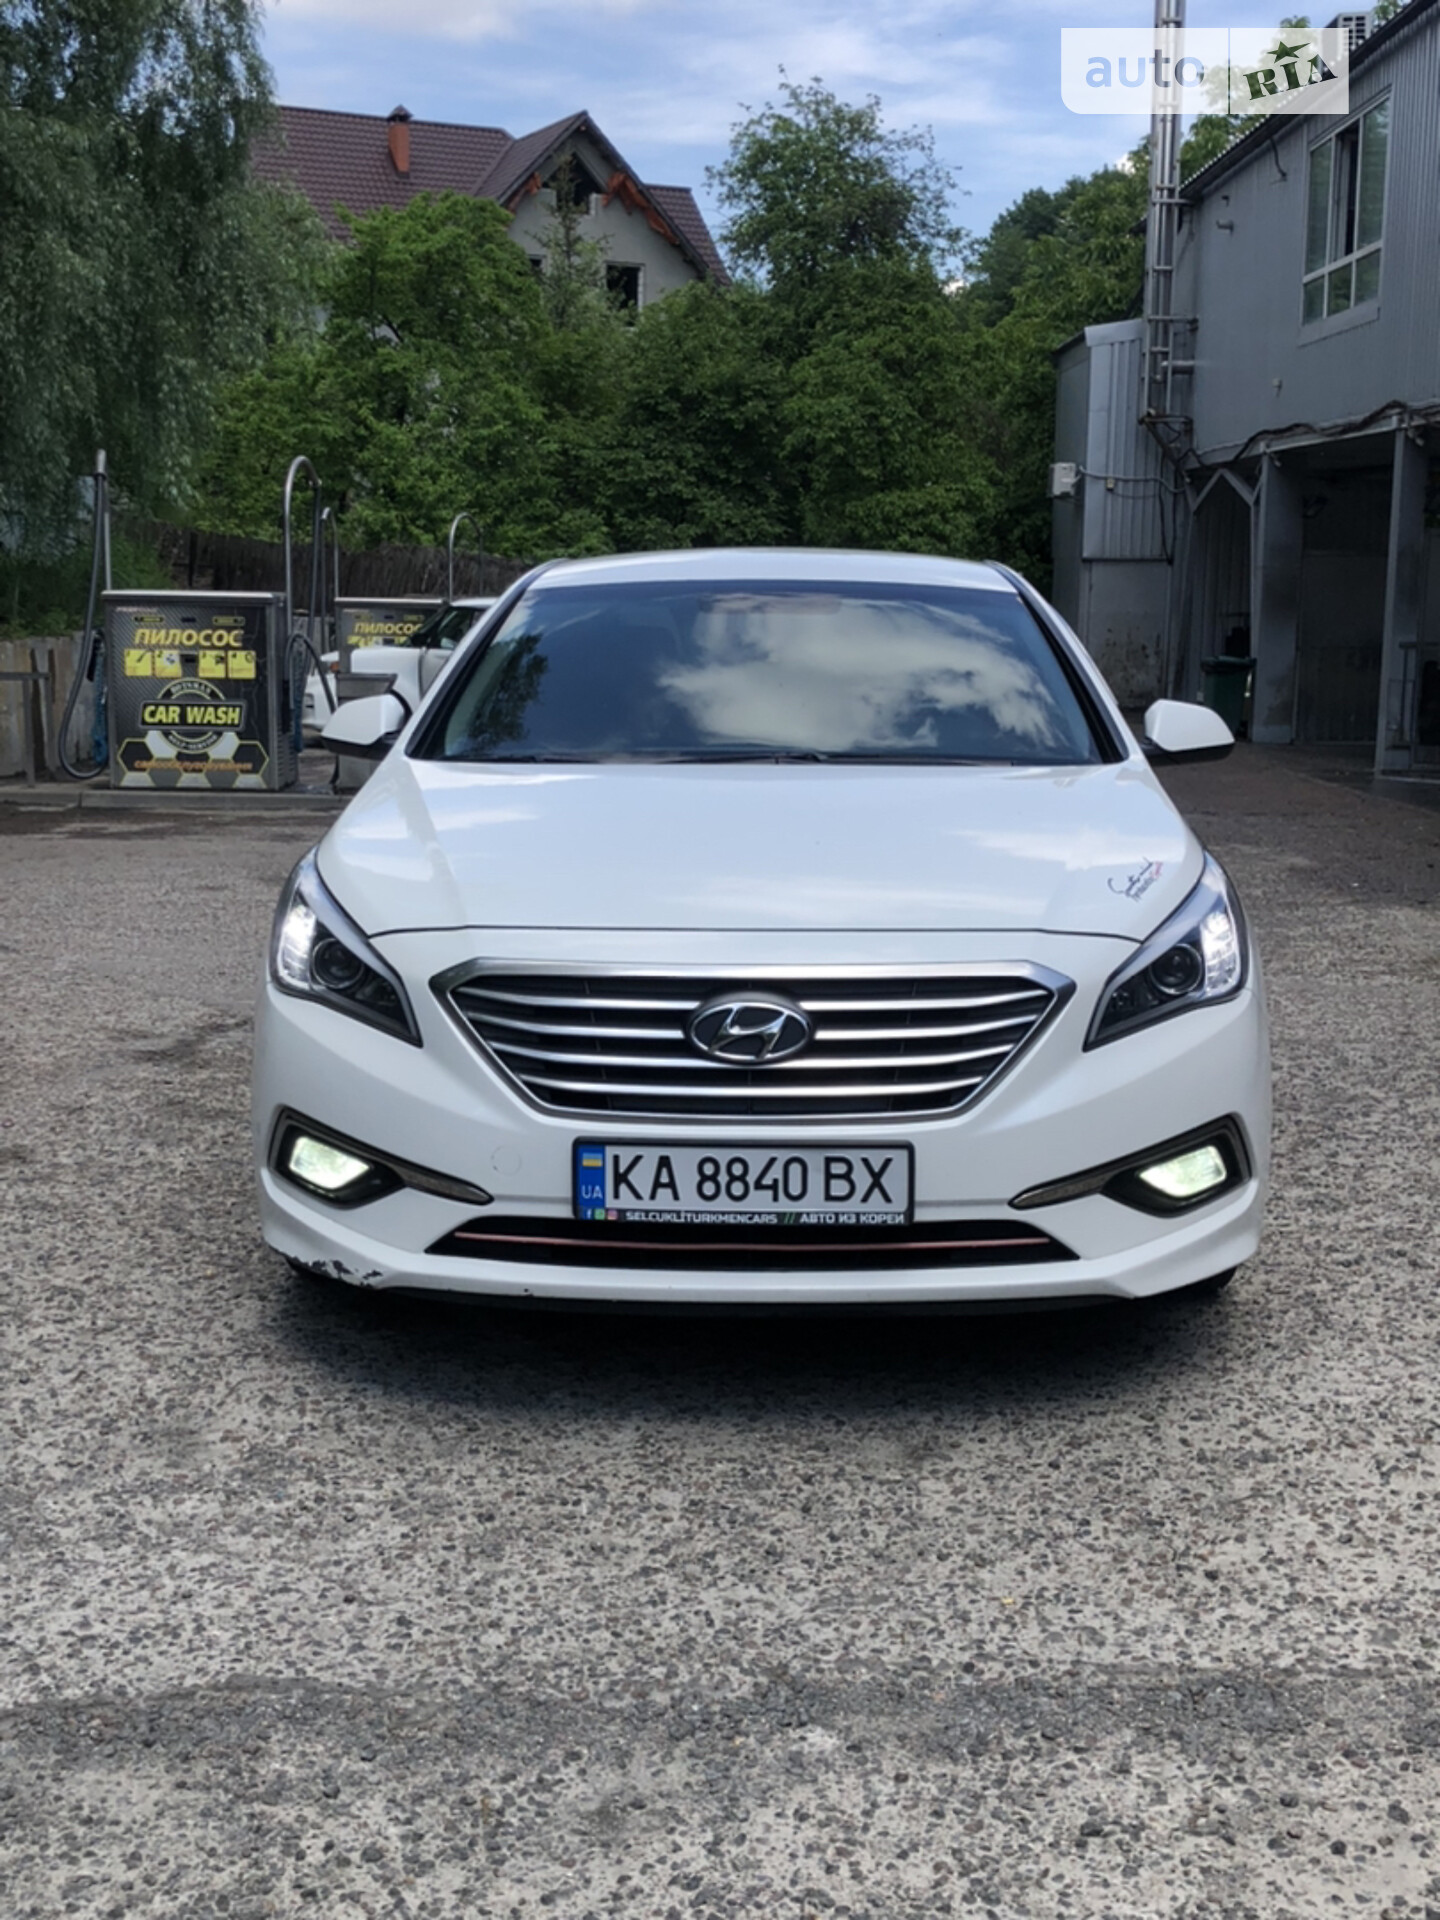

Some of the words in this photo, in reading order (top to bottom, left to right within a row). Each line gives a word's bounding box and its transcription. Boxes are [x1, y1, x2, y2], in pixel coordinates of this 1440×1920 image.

[134, 628, 244, 647] ПИЛОСОС
[143, 705, 181, 723] CAR
[186, 706, 241, 725] WASH
[612, 1154, 680, 1201] KA
[696, 1156, 808, 1202] 8840
[823, 1156, 893, 1203] BX
[581, 1185, 604, 1199] UA
[799, 1213, 836, 1224] АВТО
[838, 1213, 857, 1224] ИЗ
